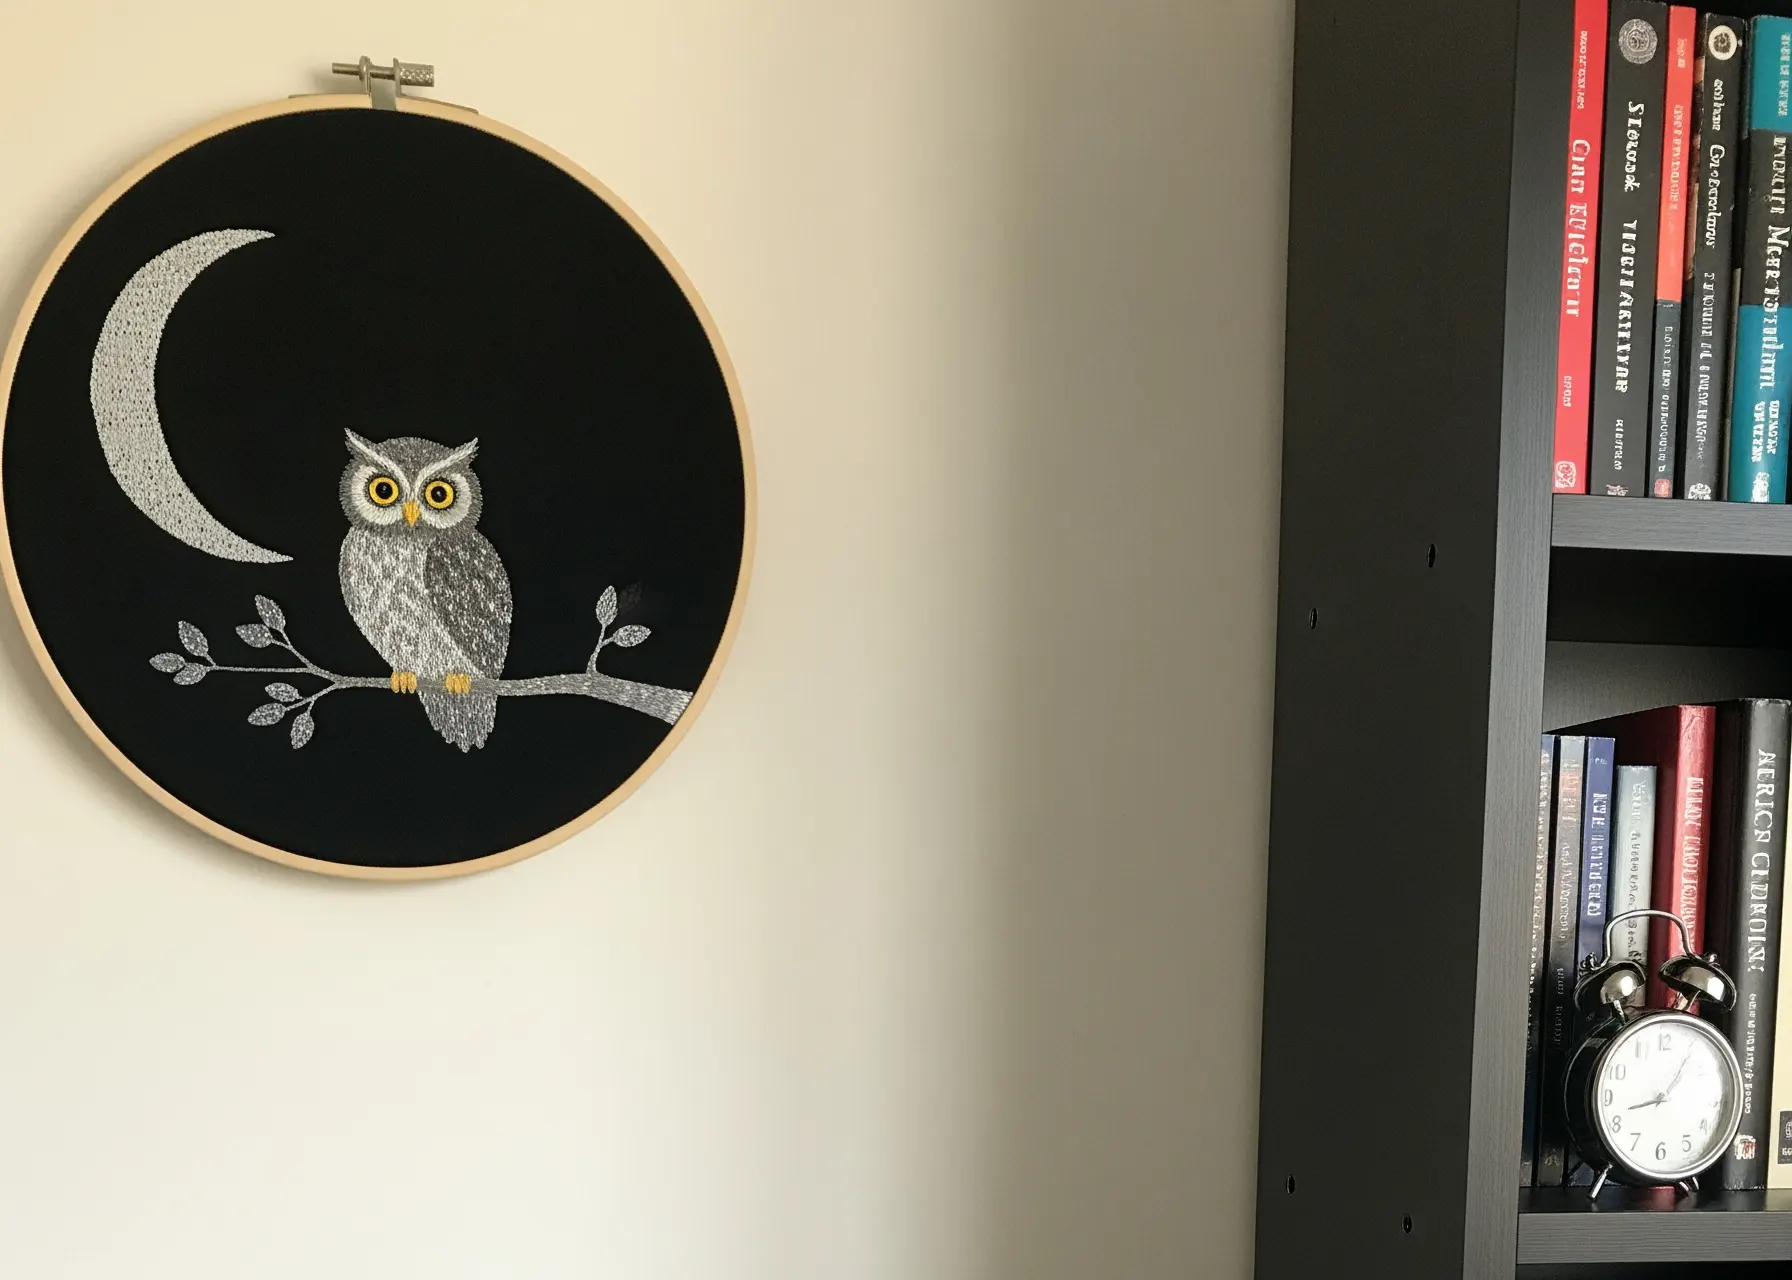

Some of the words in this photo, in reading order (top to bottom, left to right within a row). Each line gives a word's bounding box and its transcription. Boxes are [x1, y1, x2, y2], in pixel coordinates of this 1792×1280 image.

[1659, 1033, 1672, 1051] 12
[1609, 1063, 1627, 1081] 10
[1604, 1089, 1614, 1107] 9
[1611, 1115, 1622, 1133] 8
[1630, 1132, 1641, 1151] 7
[1681, 1134, 1692, 1152] 5
[1655, 1141, 1667, 1161] 6
